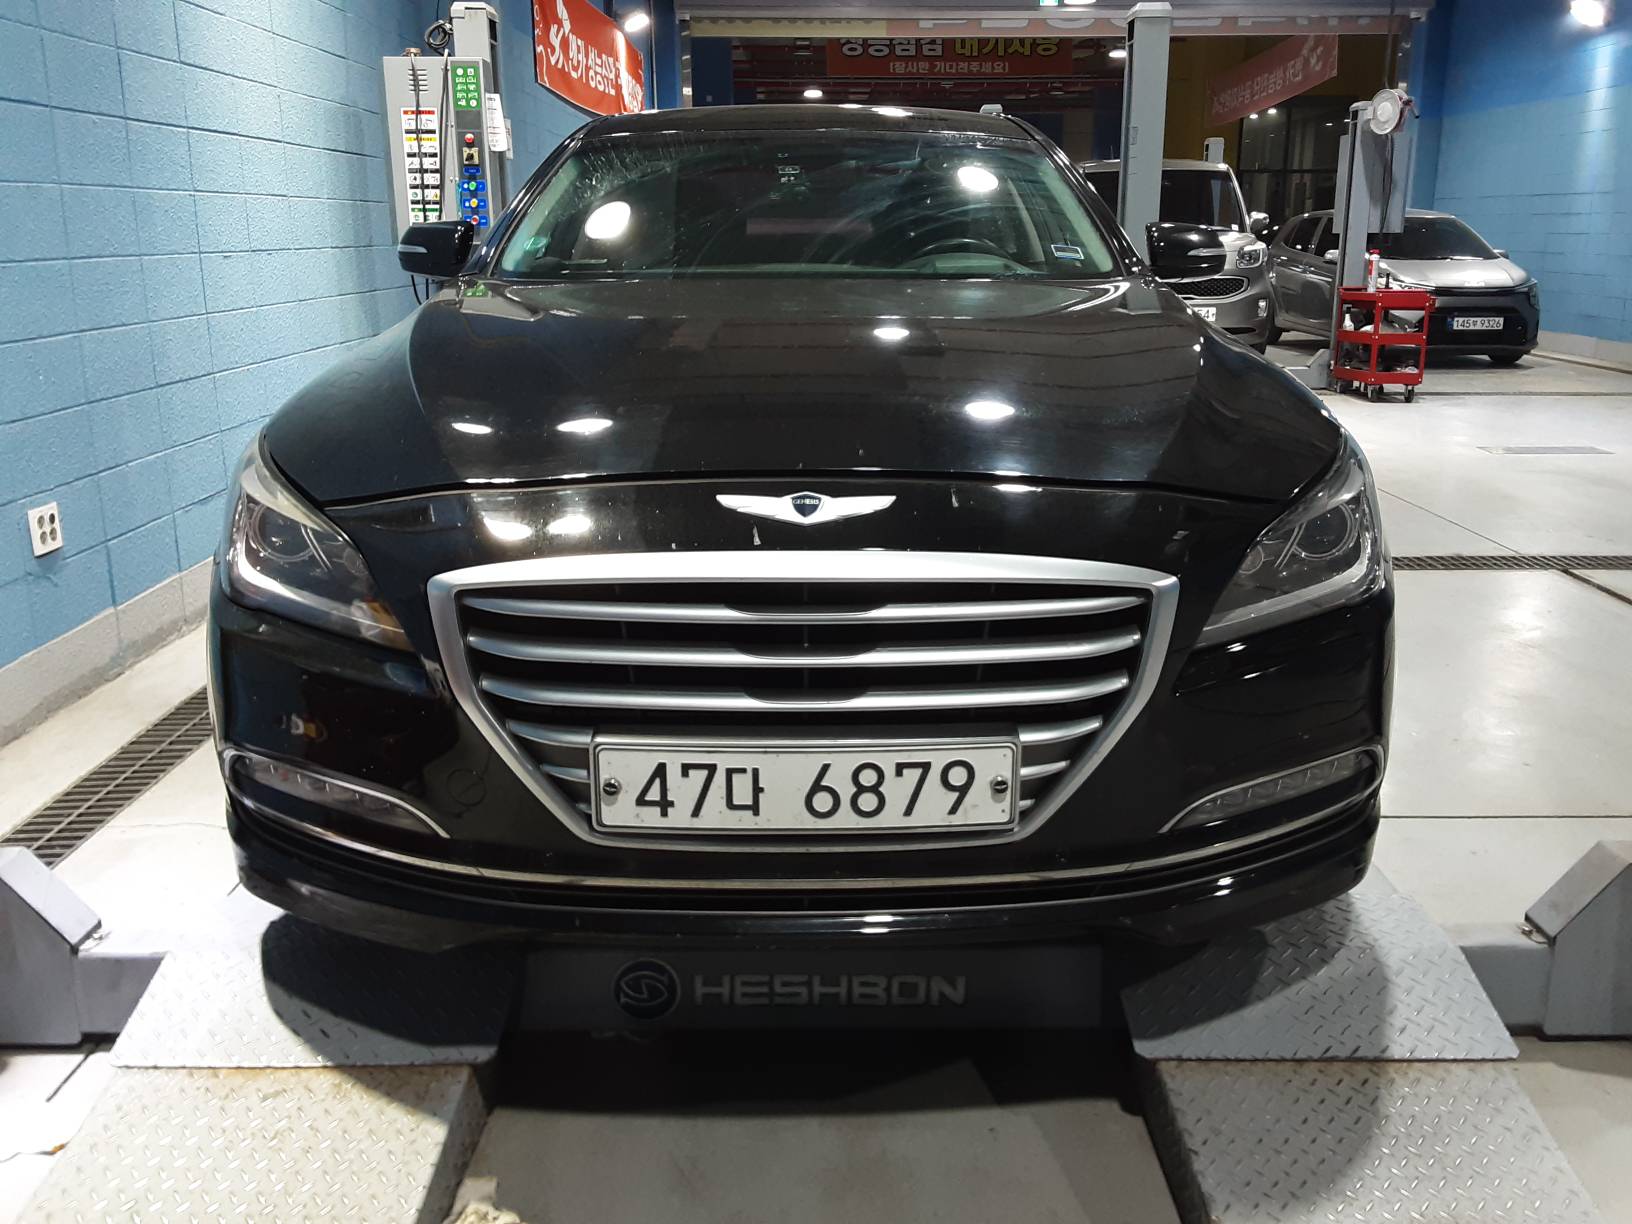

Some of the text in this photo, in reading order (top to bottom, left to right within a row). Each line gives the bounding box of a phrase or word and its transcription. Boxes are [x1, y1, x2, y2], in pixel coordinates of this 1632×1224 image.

[1480, 318, 1502, 329] 9326
[635, 759, 976, 819] 47다 6879
[693, 974, 966, 1007] HESHBON
